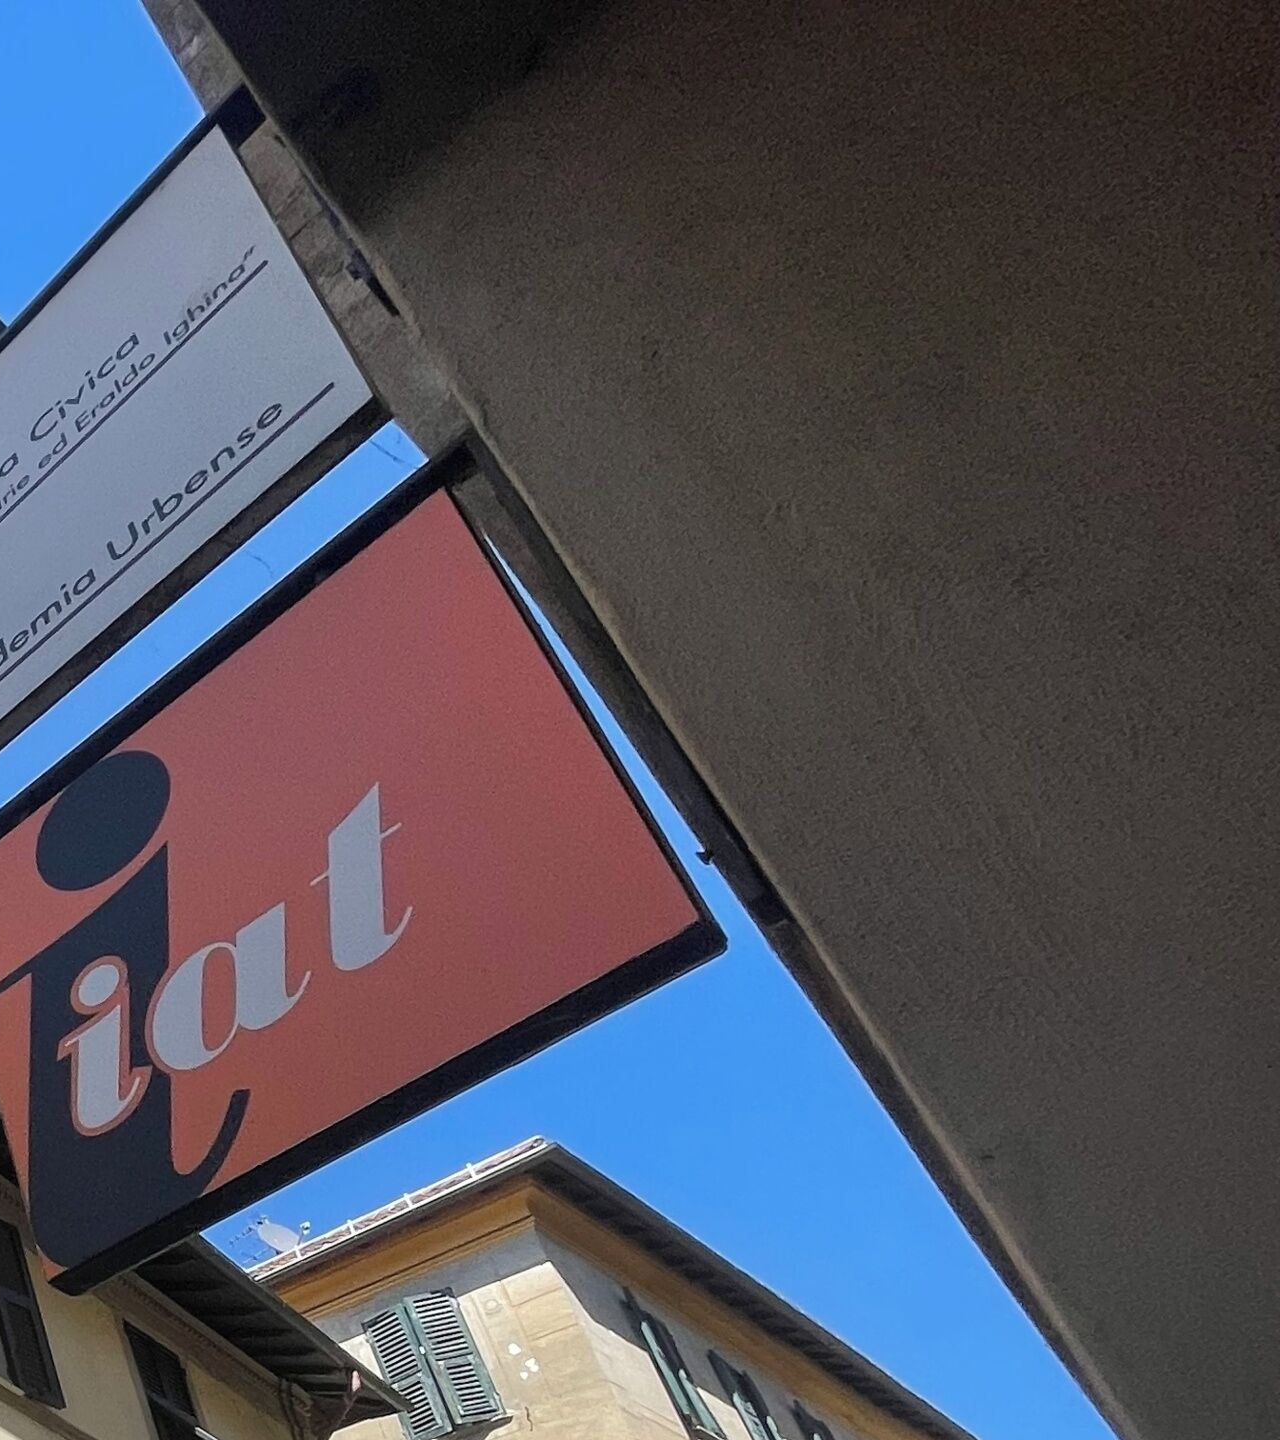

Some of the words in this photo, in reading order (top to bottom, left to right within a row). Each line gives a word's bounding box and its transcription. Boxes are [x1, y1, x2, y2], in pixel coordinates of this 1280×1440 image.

[30, 330, 140, 443] Civica
[37, 434, 69, 472] ed
[74, 351, 155, 430] Eraldo
[106, 399, 284, 564] Urbense
[60, 782, 413, 1132] iat
